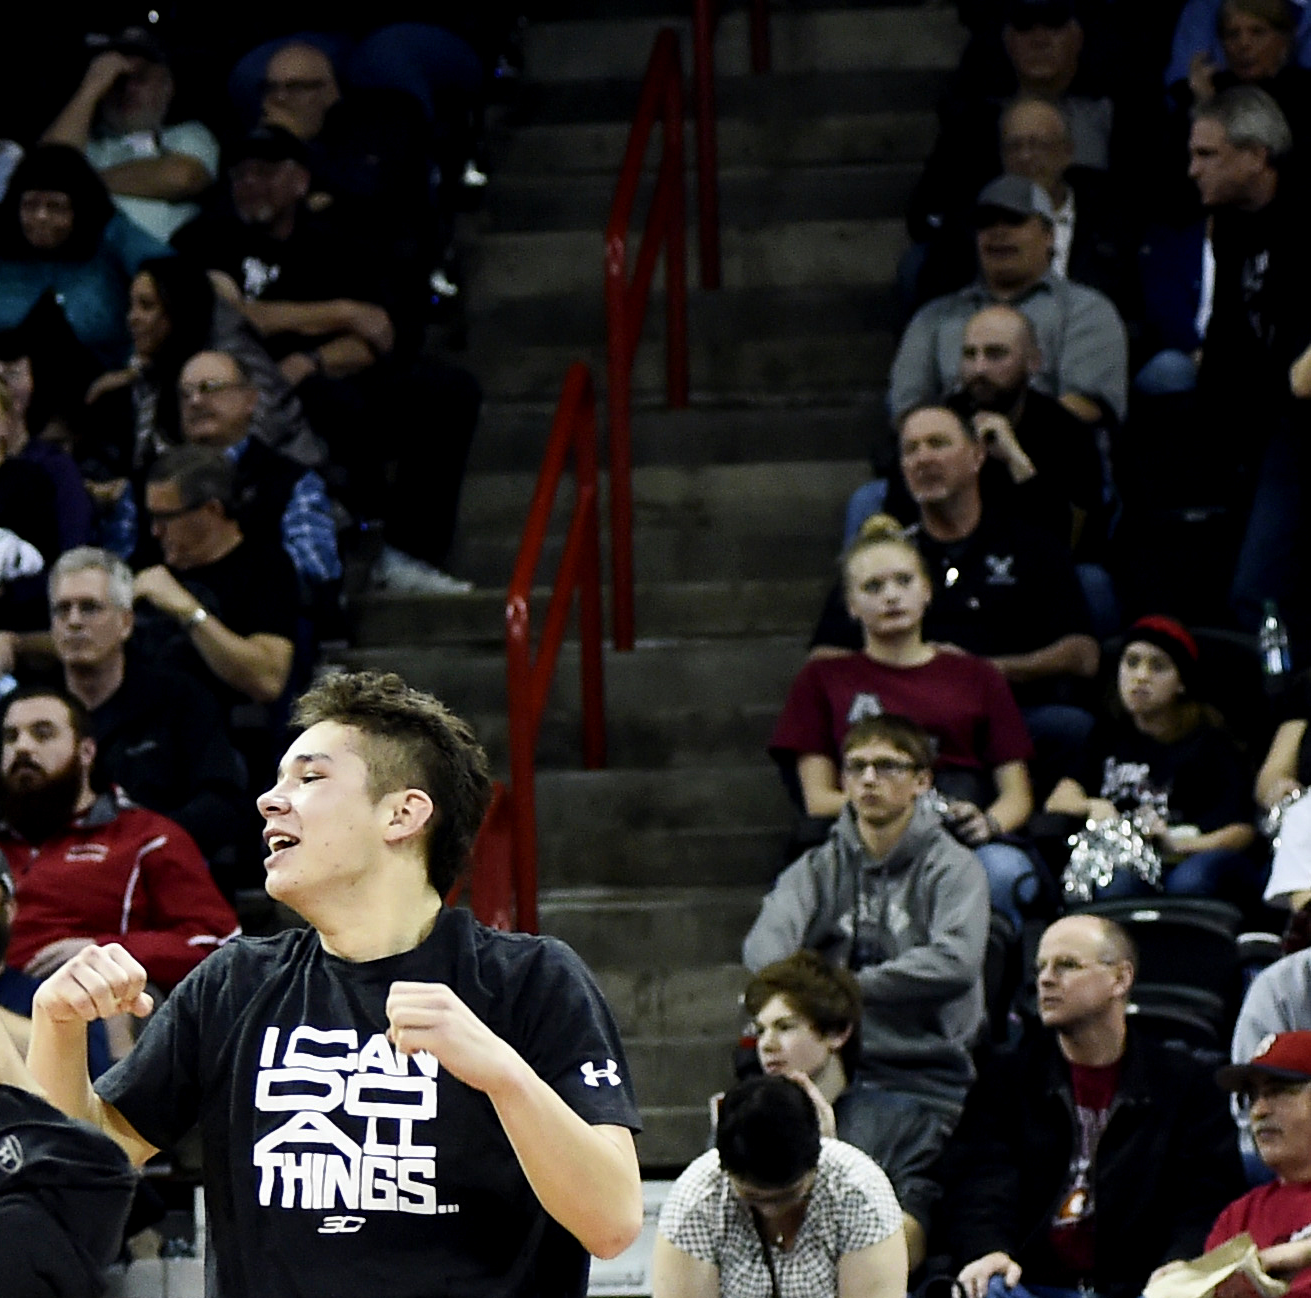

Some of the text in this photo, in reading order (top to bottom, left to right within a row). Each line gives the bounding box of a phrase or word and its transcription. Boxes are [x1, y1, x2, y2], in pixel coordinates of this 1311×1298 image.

[259, 1025, 439, 1078] I CAN
[255, 1067, 437, 1120] DO
[254, 1110, 437, 1158] ALL
